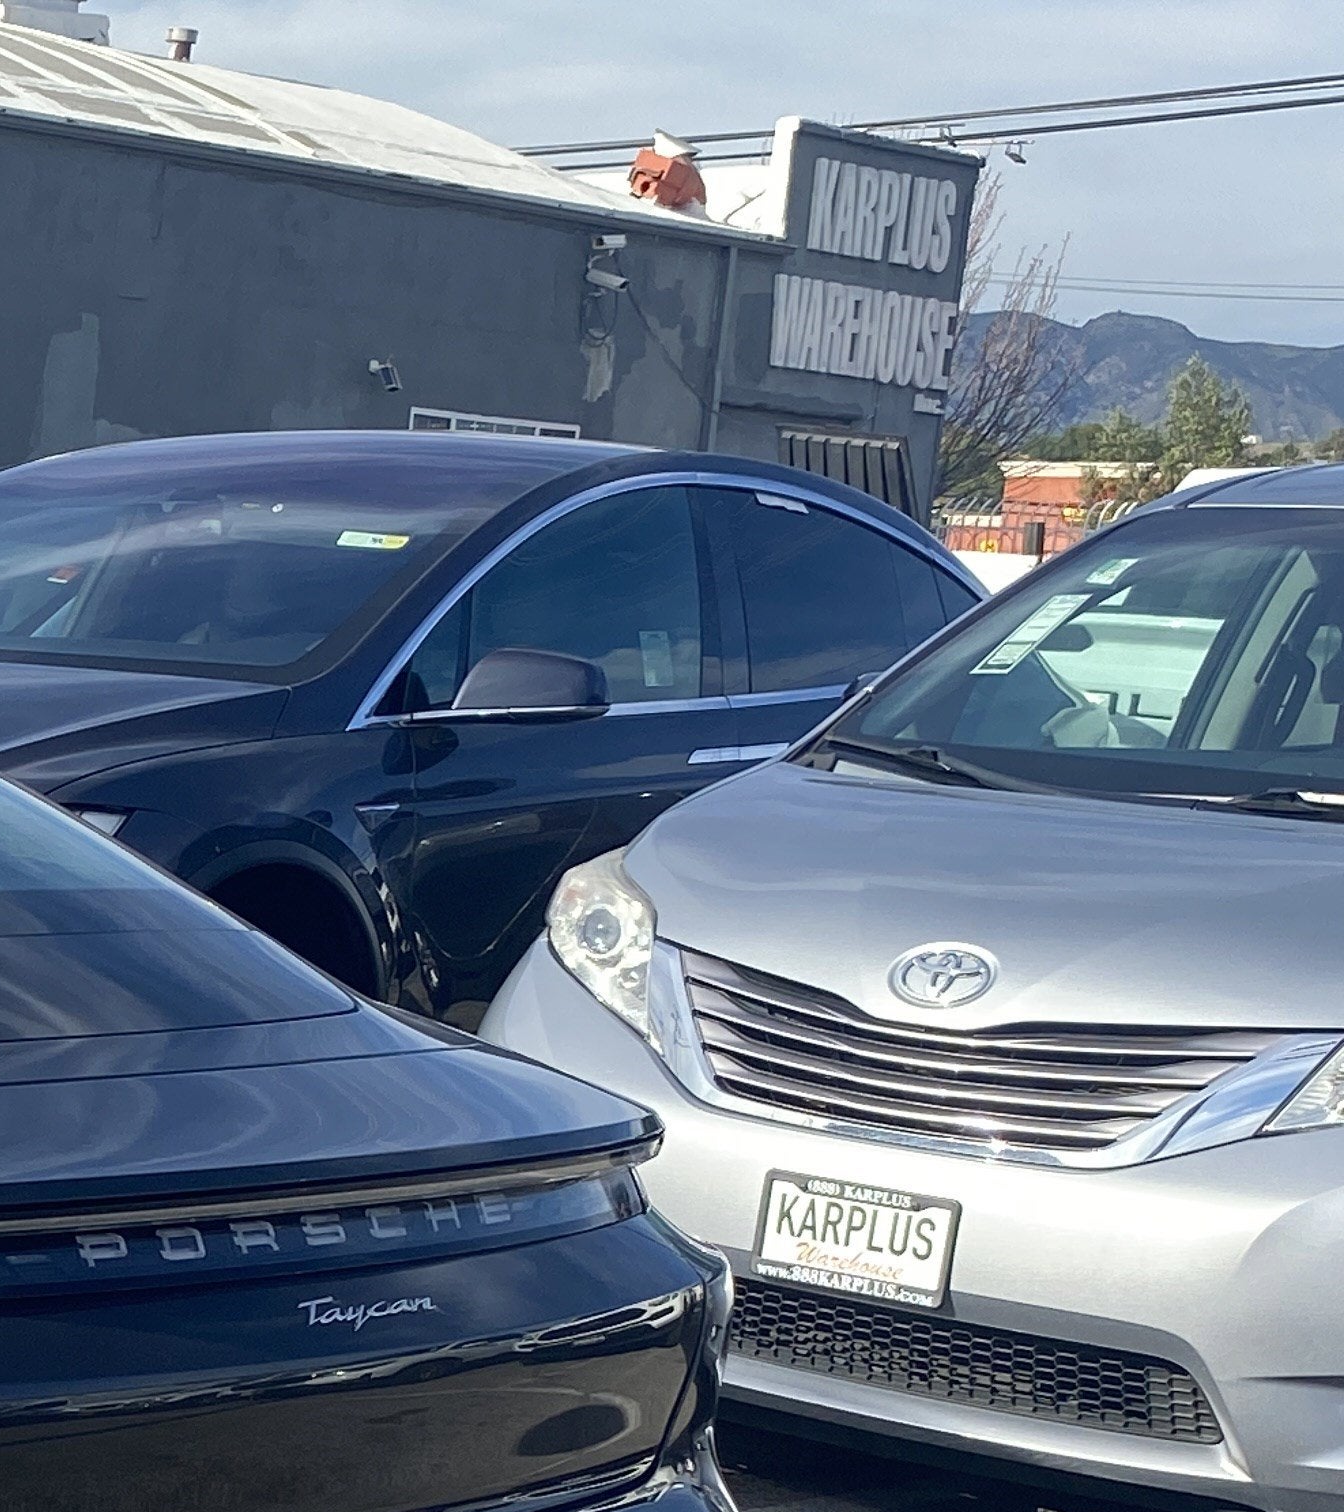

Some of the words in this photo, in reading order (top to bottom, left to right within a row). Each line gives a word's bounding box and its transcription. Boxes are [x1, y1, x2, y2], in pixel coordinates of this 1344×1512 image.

[807, 157, 957, 273] KARPLUS
[770, 274, 957, 390] WAREHOUSE
[776, 1193, 936, 1260] KARPLUS
[843, 1185, 912, 1208] KARPLUS
[75, 1195, 513, 1267] PORSCHE
[796, 1242, 905, 1280] Warehouse
[297, 1293, 436, 1331] Taycan
